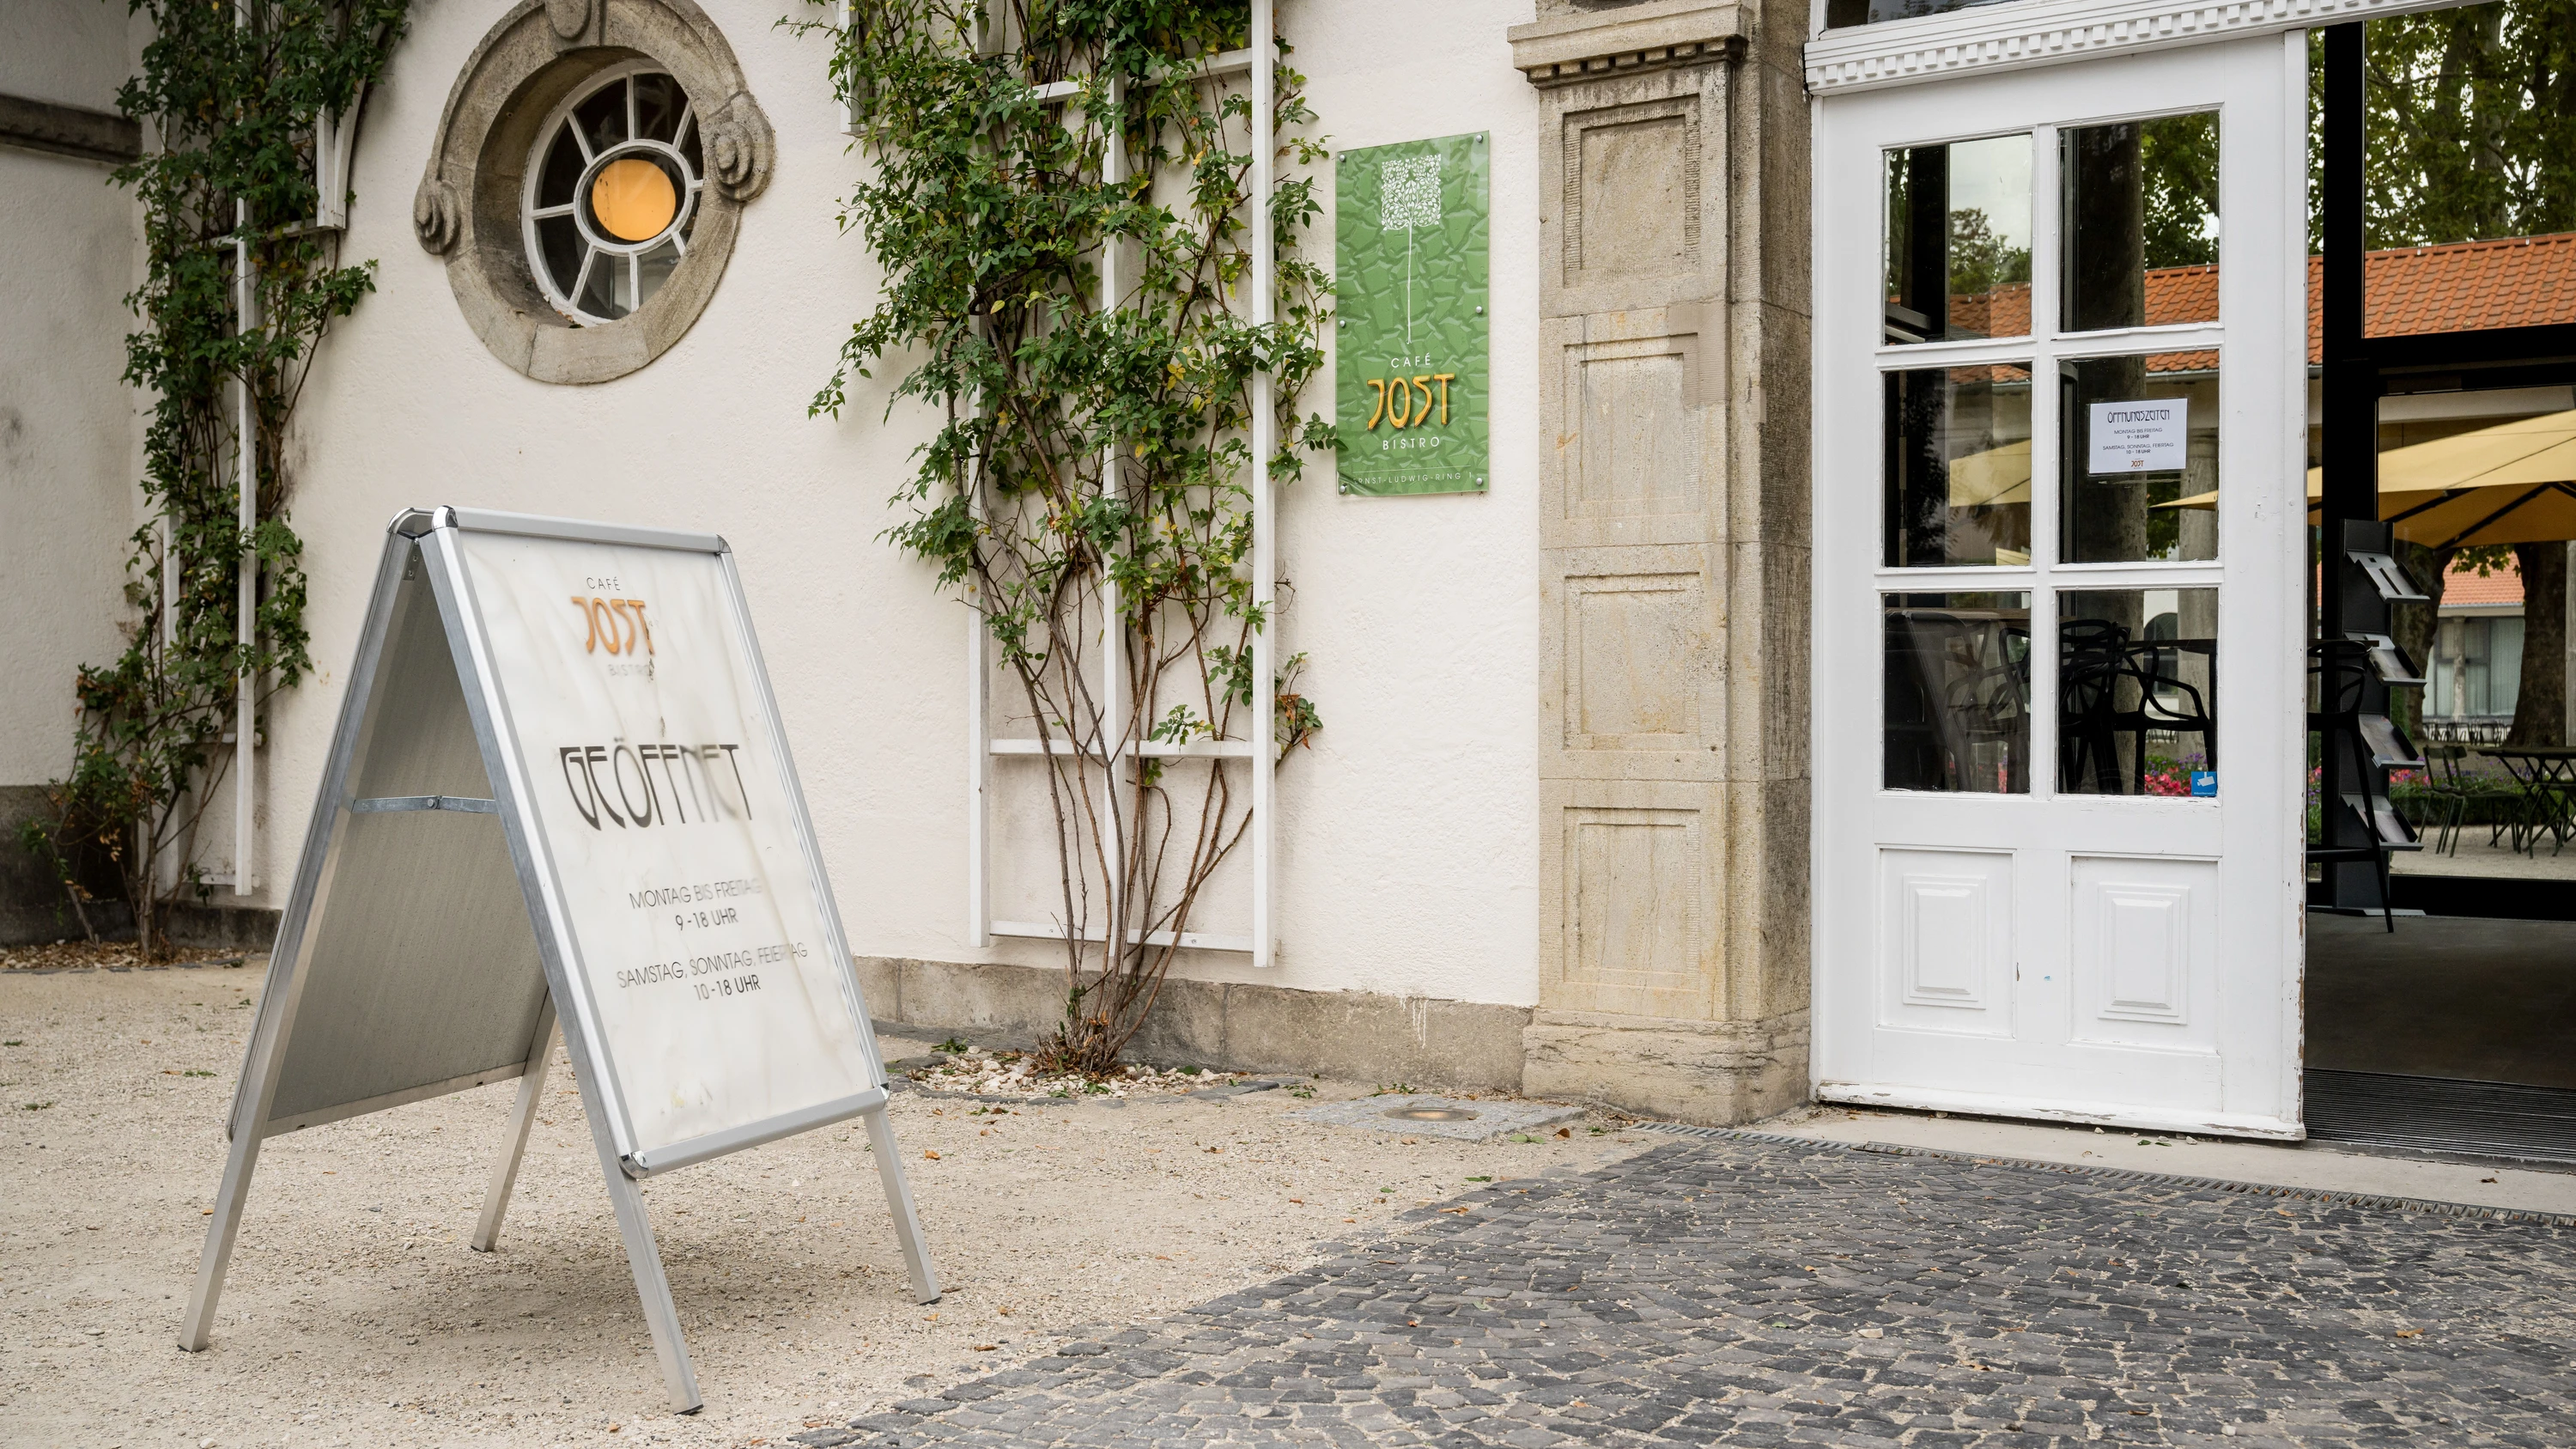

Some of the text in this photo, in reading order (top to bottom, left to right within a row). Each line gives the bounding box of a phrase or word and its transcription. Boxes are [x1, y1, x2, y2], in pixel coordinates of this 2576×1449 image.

[1391, 353, 1431, 368] CAFÉ
[1367, 373, 1455, 430] JOST
[1382, 436, 1440, 450] BISTRO
[586, 576, 621, 591] CAFÉ
[570, 596, 655, 655] JOST
[559, 737, 752, 831] GEÖFFNET
[629, 886, 691, 909] MONTAG
[693, 885, 714, 902] BIS
[710, 908, 738, 926] UHR
[617, 961, 688, 989] SAMSTAG,
[689, 950, 756, 976] SONNTAG,
[734, 974, 762, 993] UHR
